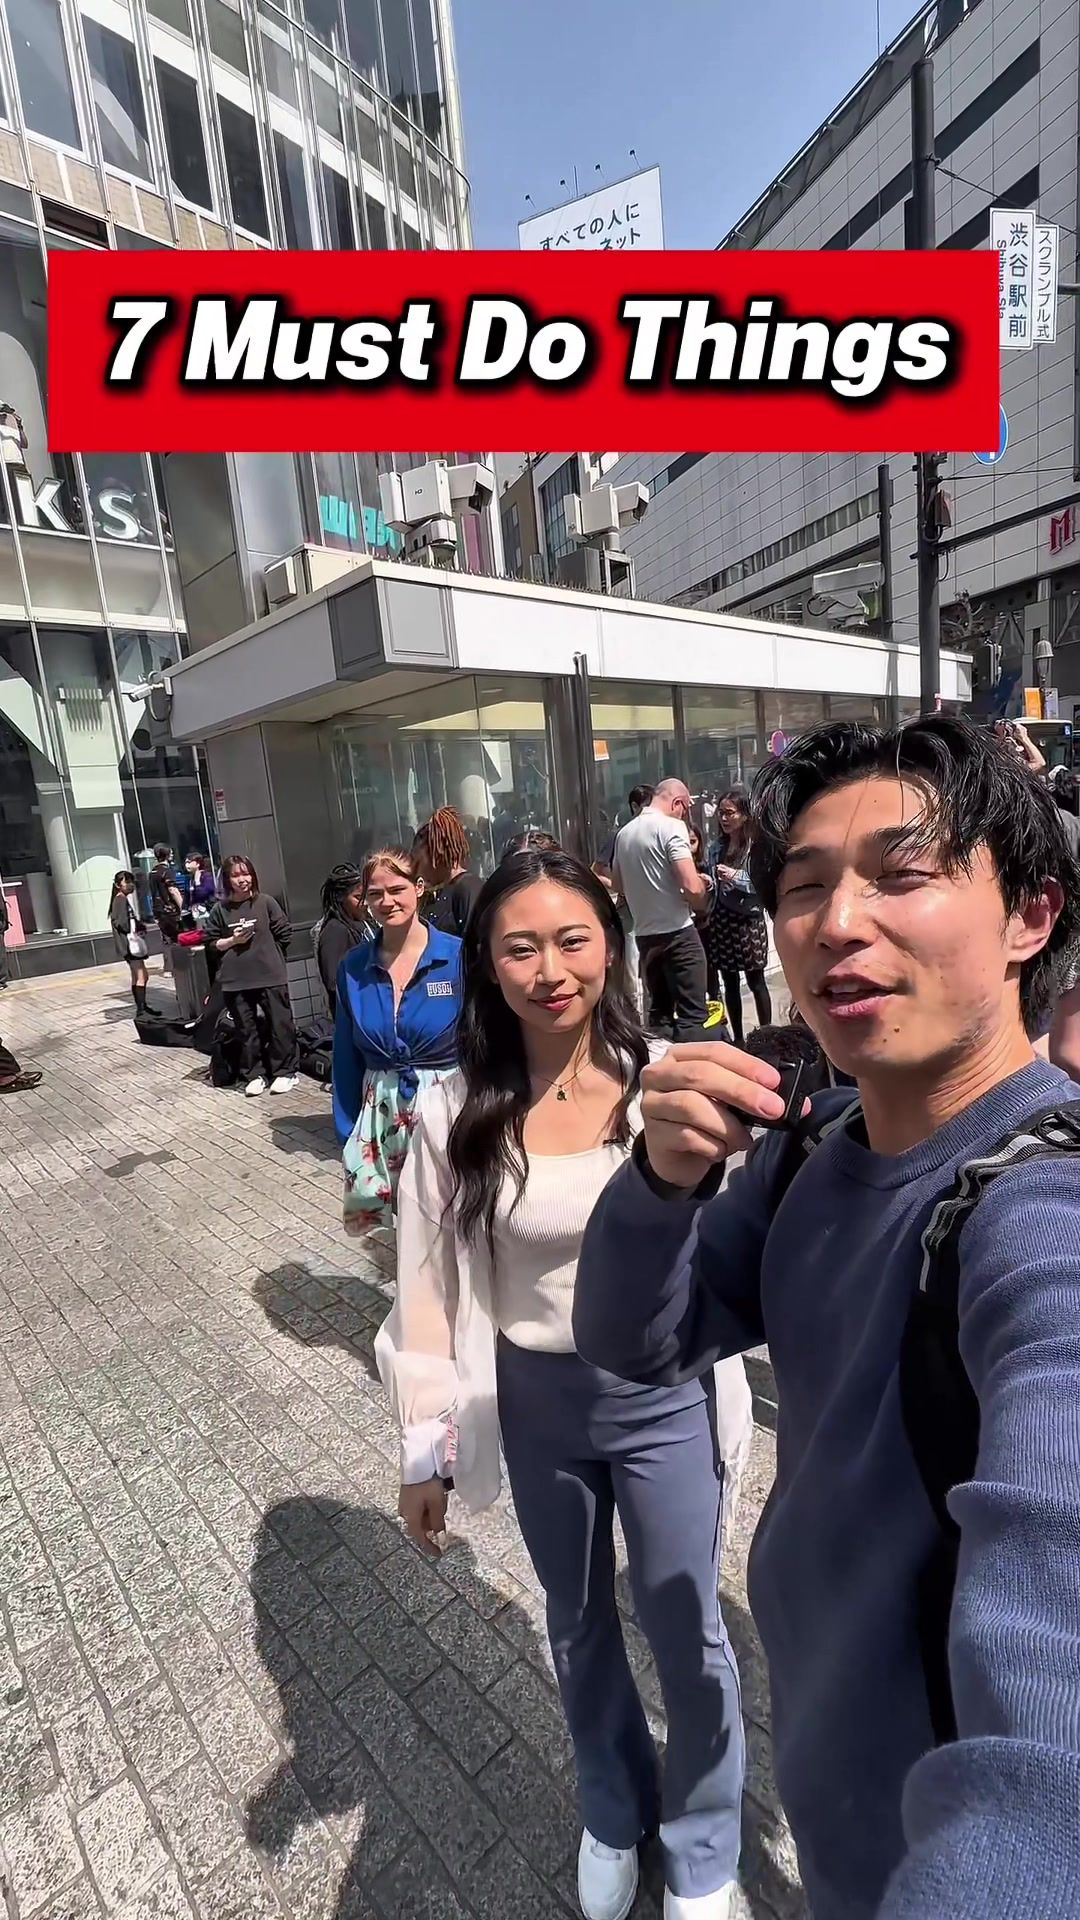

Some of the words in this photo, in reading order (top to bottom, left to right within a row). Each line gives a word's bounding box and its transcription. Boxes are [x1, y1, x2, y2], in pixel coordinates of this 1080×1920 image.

[540, 202, 640, 250] すべての人に
[1009, 222, 1028, 338] 渋谷駅前
